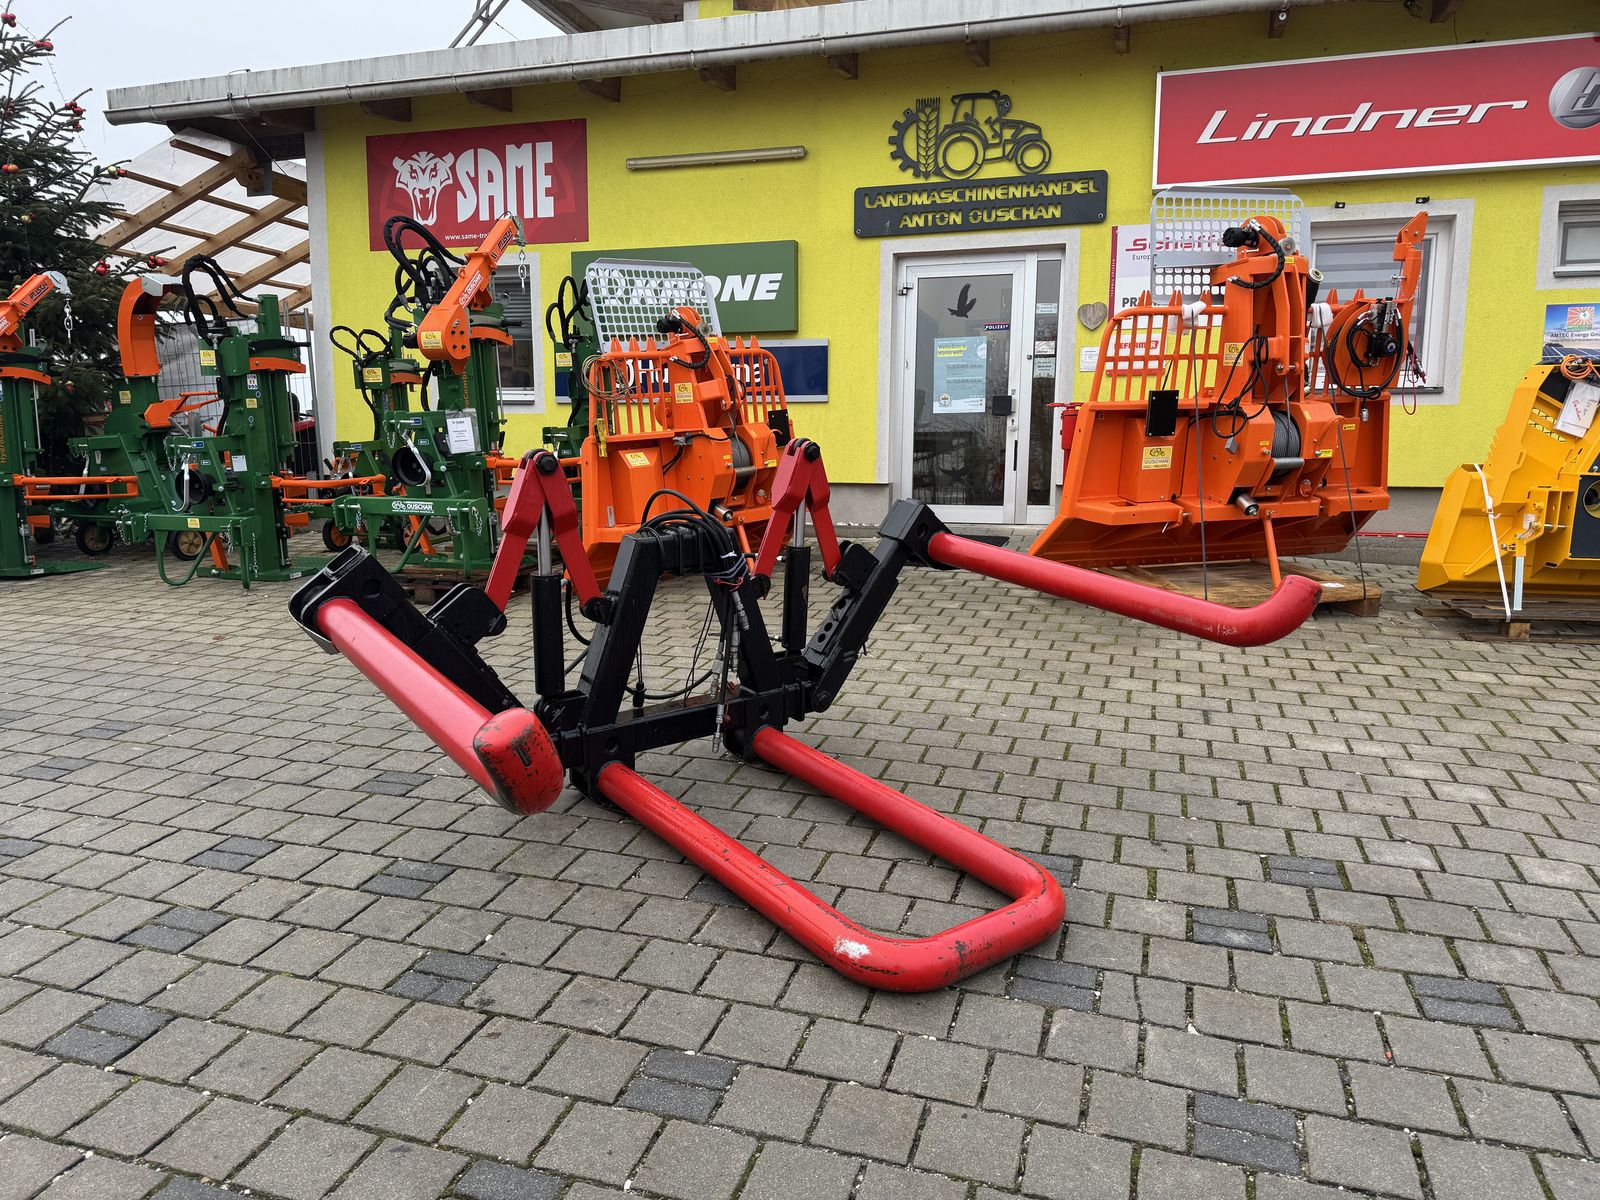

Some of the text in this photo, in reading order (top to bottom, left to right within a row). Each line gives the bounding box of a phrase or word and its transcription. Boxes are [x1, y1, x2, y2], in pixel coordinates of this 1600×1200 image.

[1196, 100, 1529, 144] Lindner
[455, 141, 555, 223] SAME
[864, 177, 1100, 209] LANDMASCHINENHANDEL
[899, 203, 1062, 228] ANTON OUSCHAN
